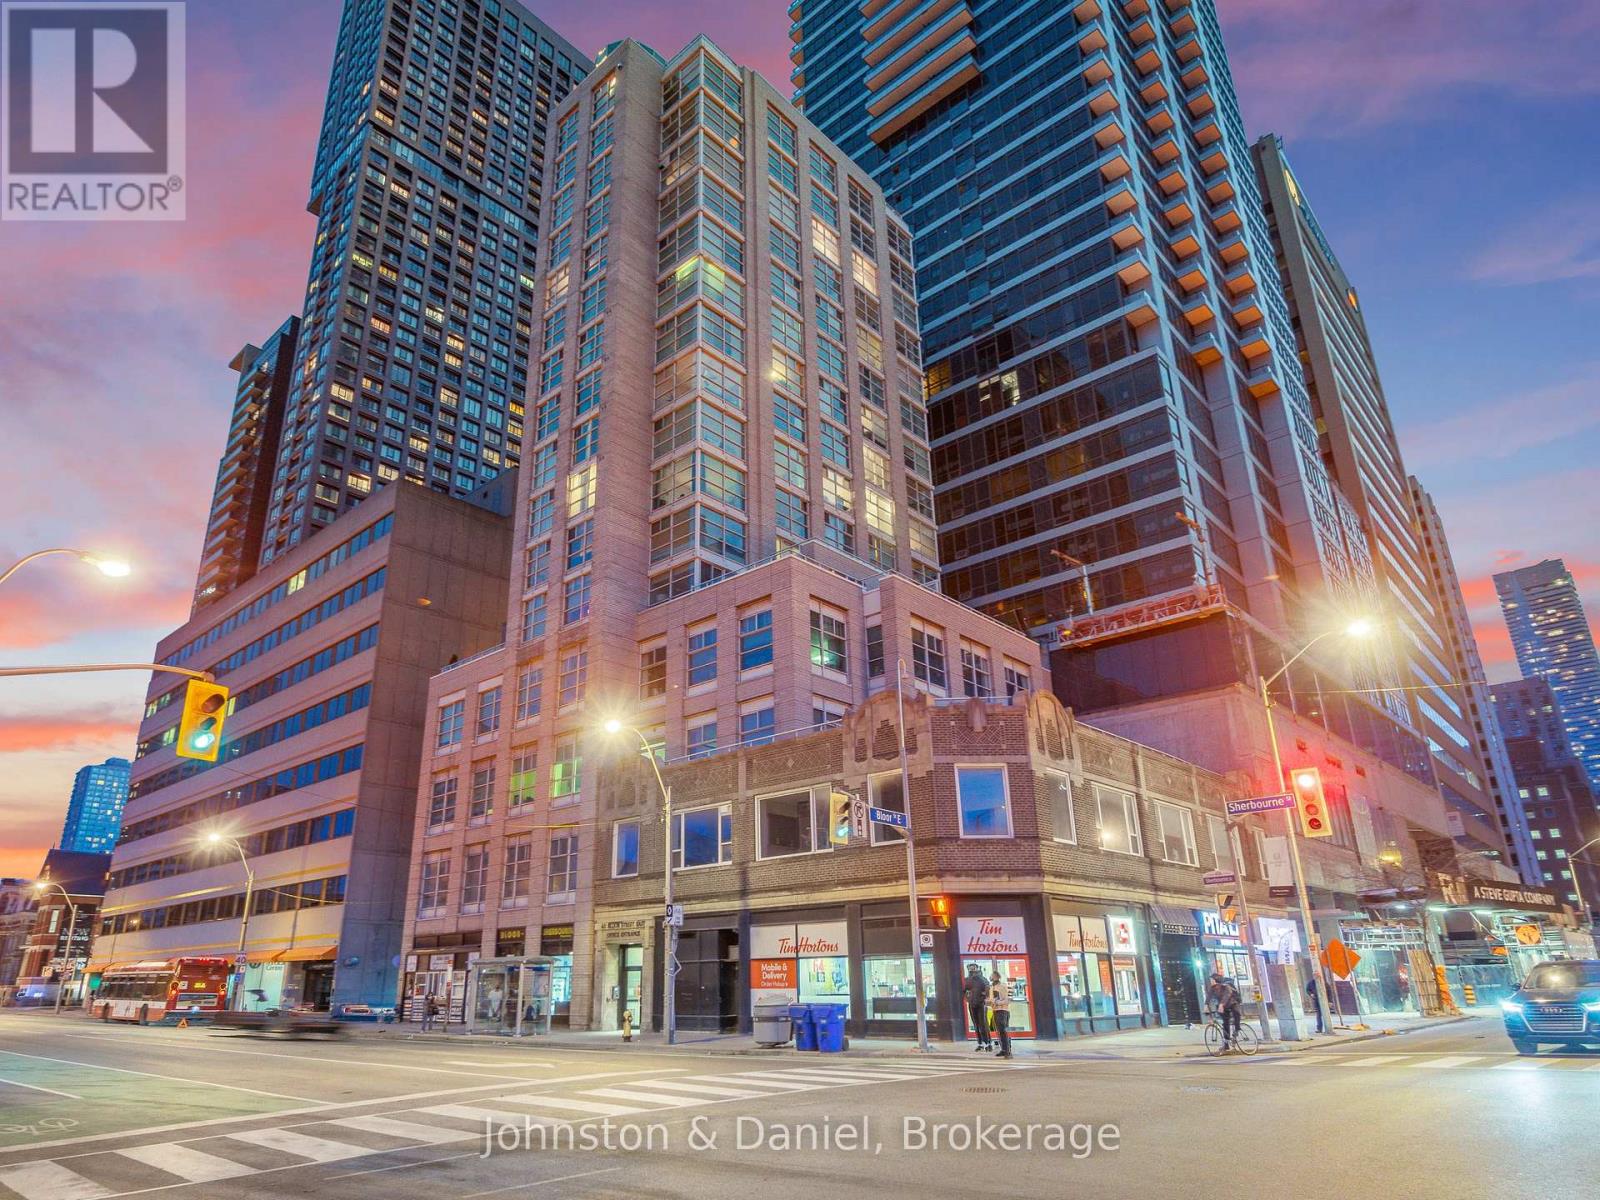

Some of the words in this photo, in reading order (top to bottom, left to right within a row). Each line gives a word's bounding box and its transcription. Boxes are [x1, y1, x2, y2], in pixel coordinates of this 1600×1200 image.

[1228, 798, 1285, 813] Sherbourne
[876, 810, 892, 823] Bloor
[897, 814, 902, 824] E
[1473, 886, 1481, 899] A
[1480, 886, 1503, 901] STEVE
[1502, 888, 1524, 903] GUPTA
[1523, 891, 1556, 906] COMPANY
[977, 918, 1002, 935] Tim
[778, 937, 797, 954] Tim
[796, 935, 839, 953] Hortons
[967, 935, 1018, 953] Hortons
[1067, 930, 1082, 948] Tim
[1080, 929, 1108, 949] Hortons
[235, 956, 247, 964] 40
[761, 963, 782, 972] Mobile
[782, 963, 788, 971] &
[762, 972, 787, 981] Delivery
